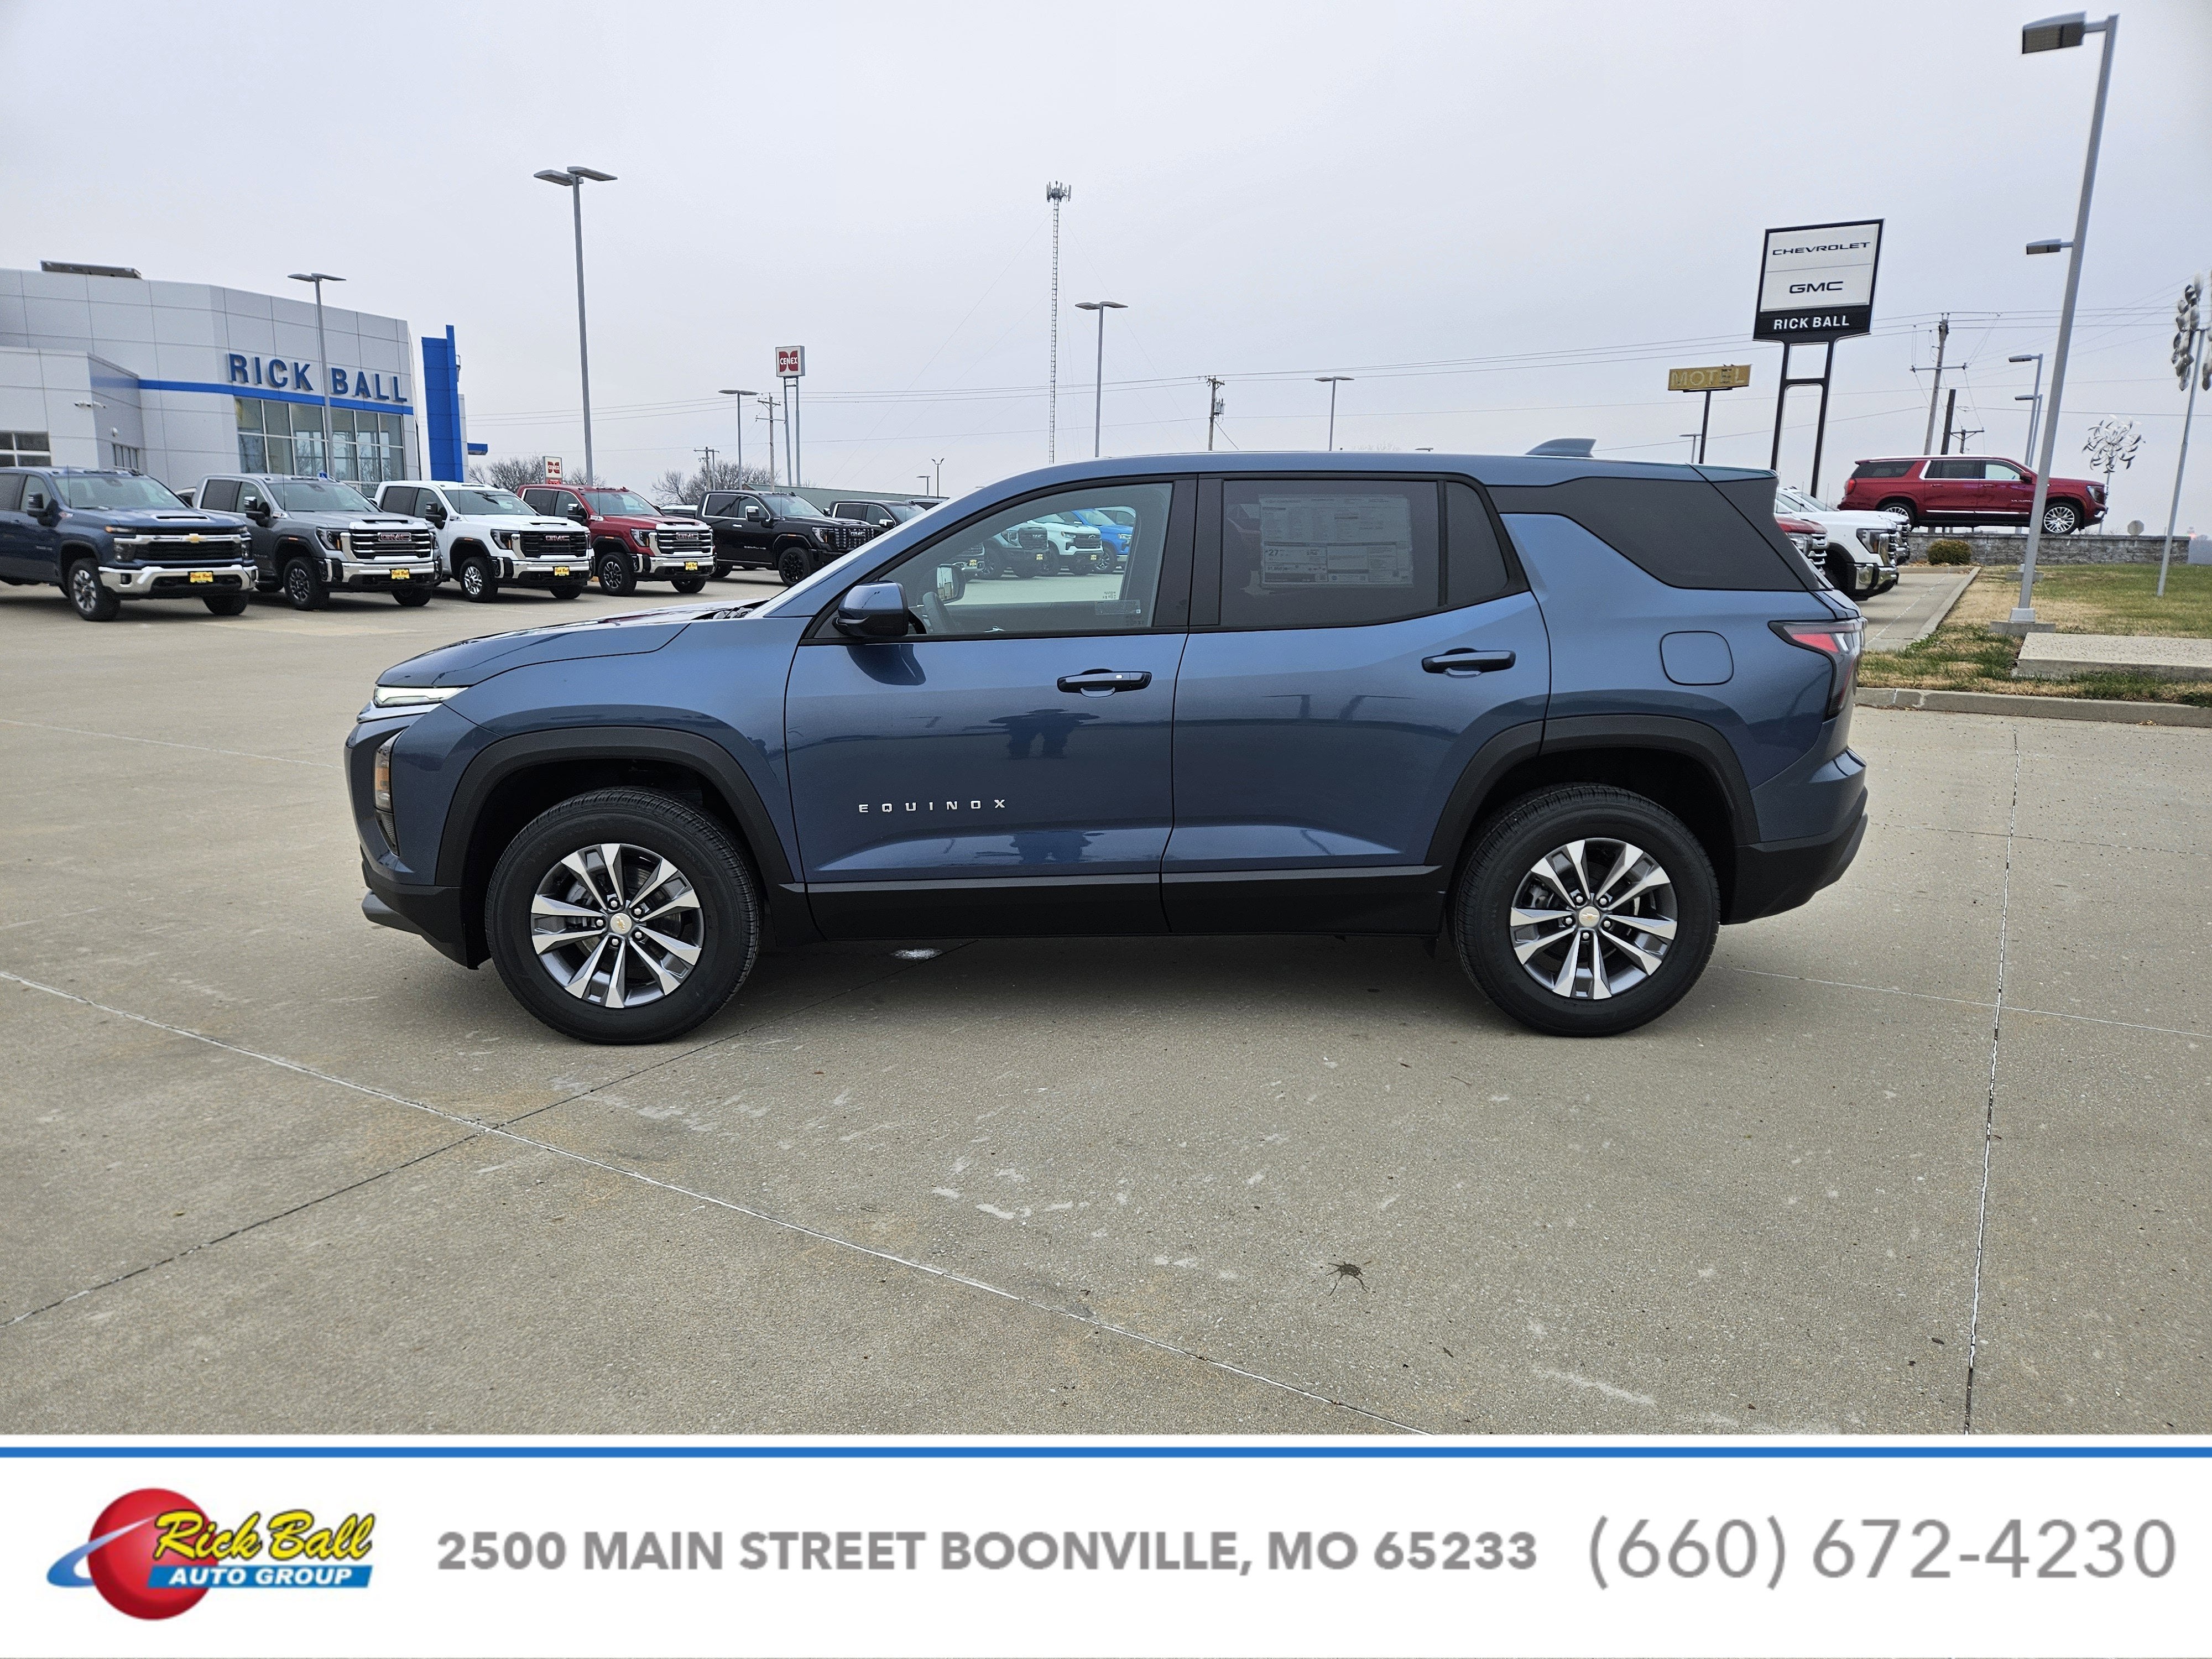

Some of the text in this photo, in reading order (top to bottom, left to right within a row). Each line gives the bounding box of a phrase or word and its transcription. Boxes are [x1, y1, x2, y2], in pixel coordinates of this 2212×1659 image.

[1772, 242, 1871, 255] CHEVROLET
[1789, 281, 1844, 294] GMC
[1773, 315, 1850, 330] RICK BALL
[780, 357, 798, 365] CENEX
[227, 352, 408, 403] RICK BALL
[1671, 367, 1745, 387] MOTEL
[858, 799, 1005, 813] EQUINOX
